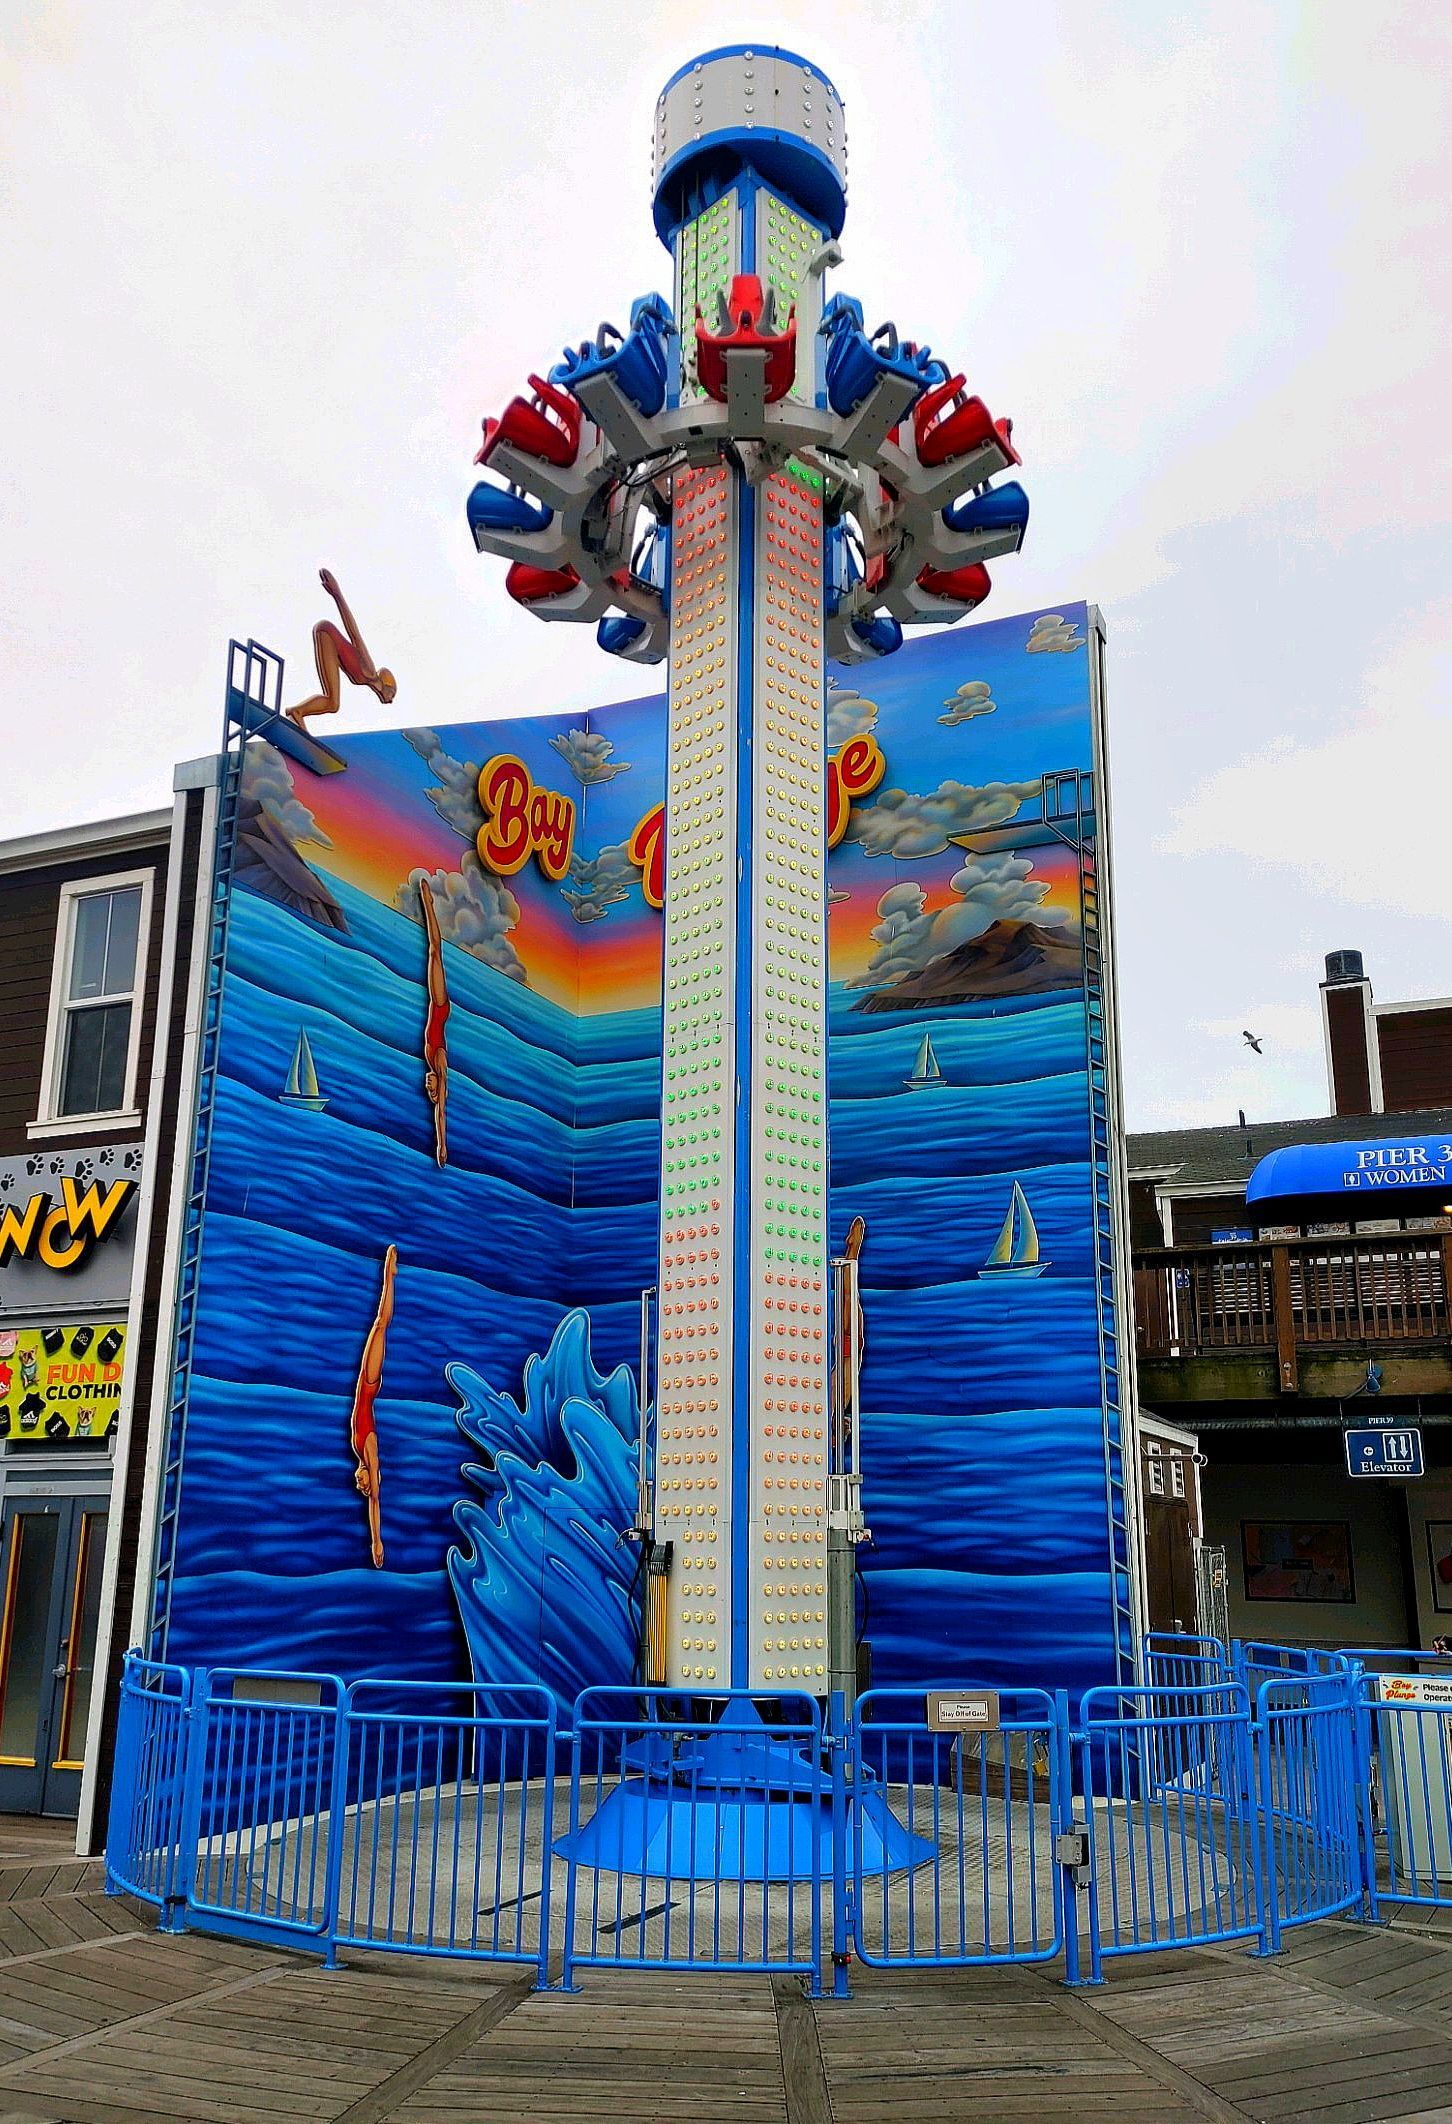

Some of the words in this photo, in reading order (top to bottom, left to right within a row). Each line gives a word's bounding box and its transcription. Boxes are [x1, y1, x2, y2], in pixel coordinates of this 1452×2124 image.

[477, 754, 576, 881] Bay
[1356, 1147, 1430, 1169] PIER
[1364, 1166, 1446, 1185] WOMEN
[47, 1363, 96, 1384] FUN
[1360, 1461, 1412, 1472] Elevator
[1391, 1680, 1412, 1689] Bay
[1423, 1684, 1448, 1692] Please
[1385, 1690, 1416, 1700] Plunge
